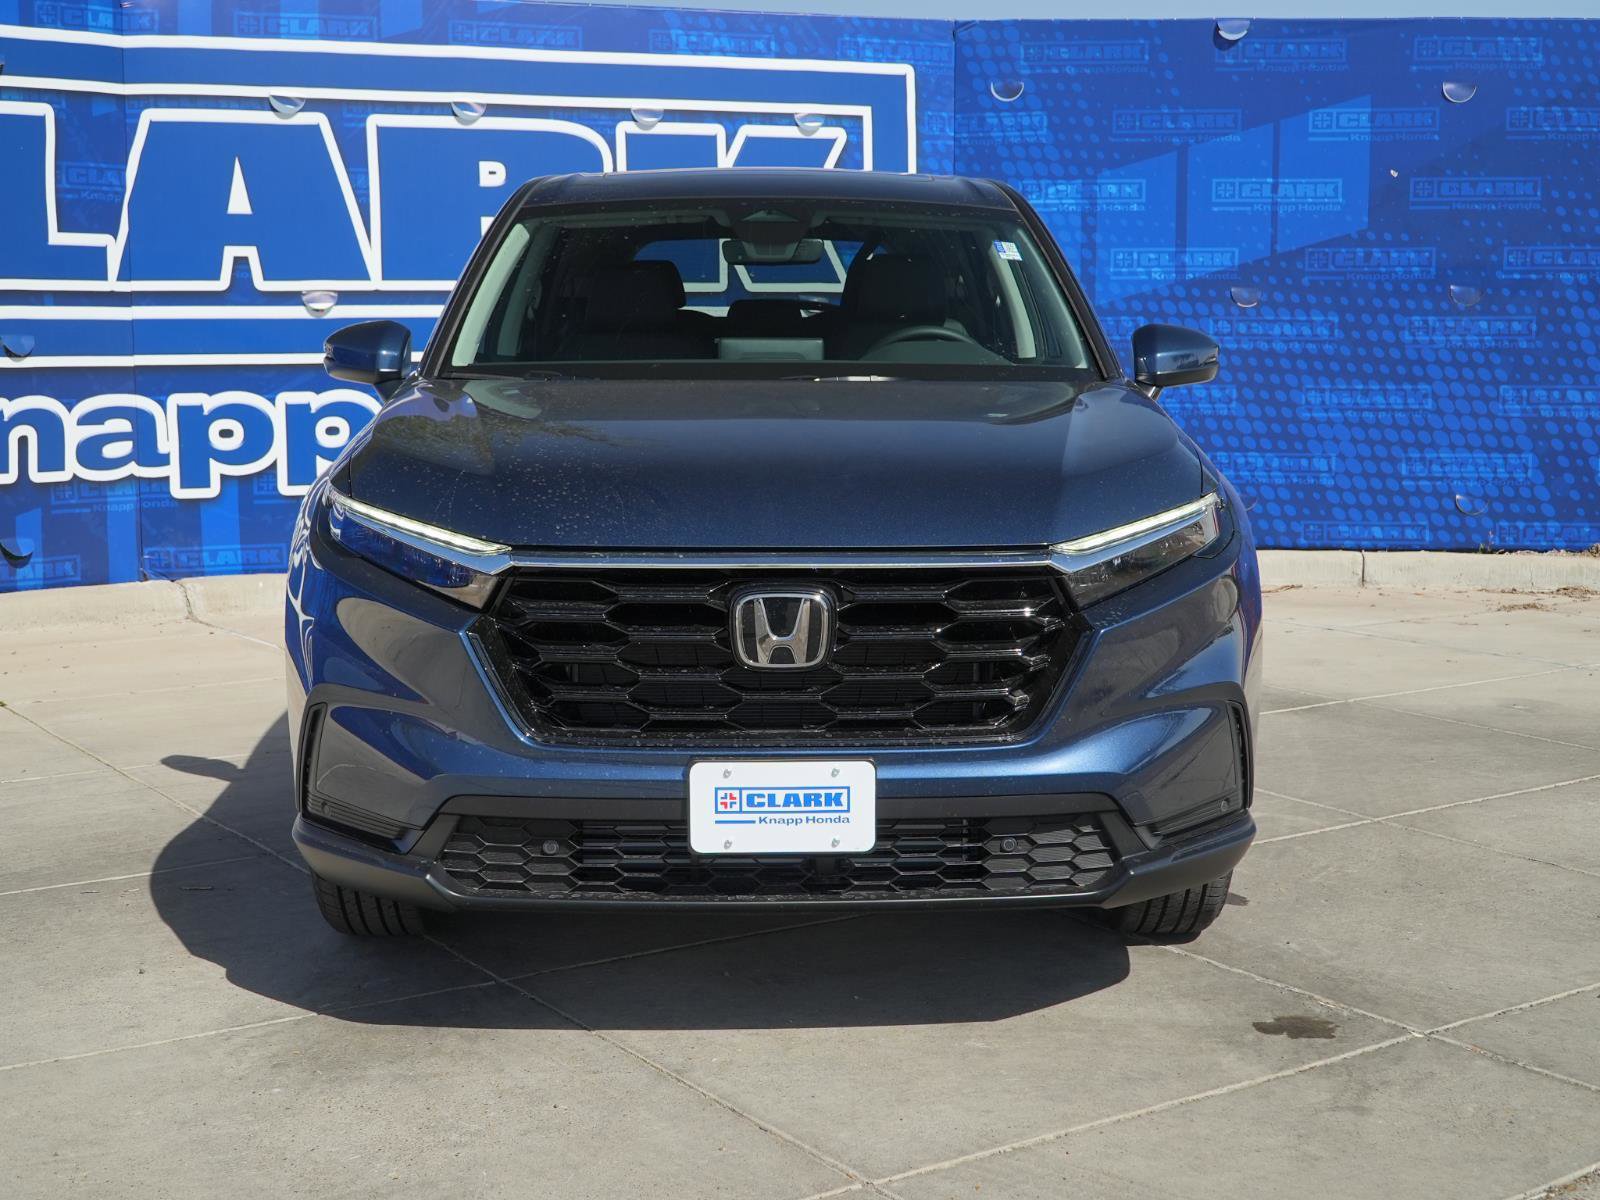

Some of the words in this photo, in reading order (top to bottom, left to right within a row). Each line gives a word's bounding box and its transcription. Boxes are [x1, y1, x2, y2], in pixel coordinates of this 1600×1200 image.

[1246, 43, 1342, 57] CLARK
[1142, 113, 1236, 128] CLARK
[1336, 112, 1433, 127] CLARK
[1240, 182, 1336, 198] CLARK
[1440, 181, 1536, 197] CLARK
[1334, 251, 1430, 266] CLARK
[746, 792, 843, 808] CLARK
[758, 815, 803, 826] Knapp
[805, 815, 850, 824] Honda
